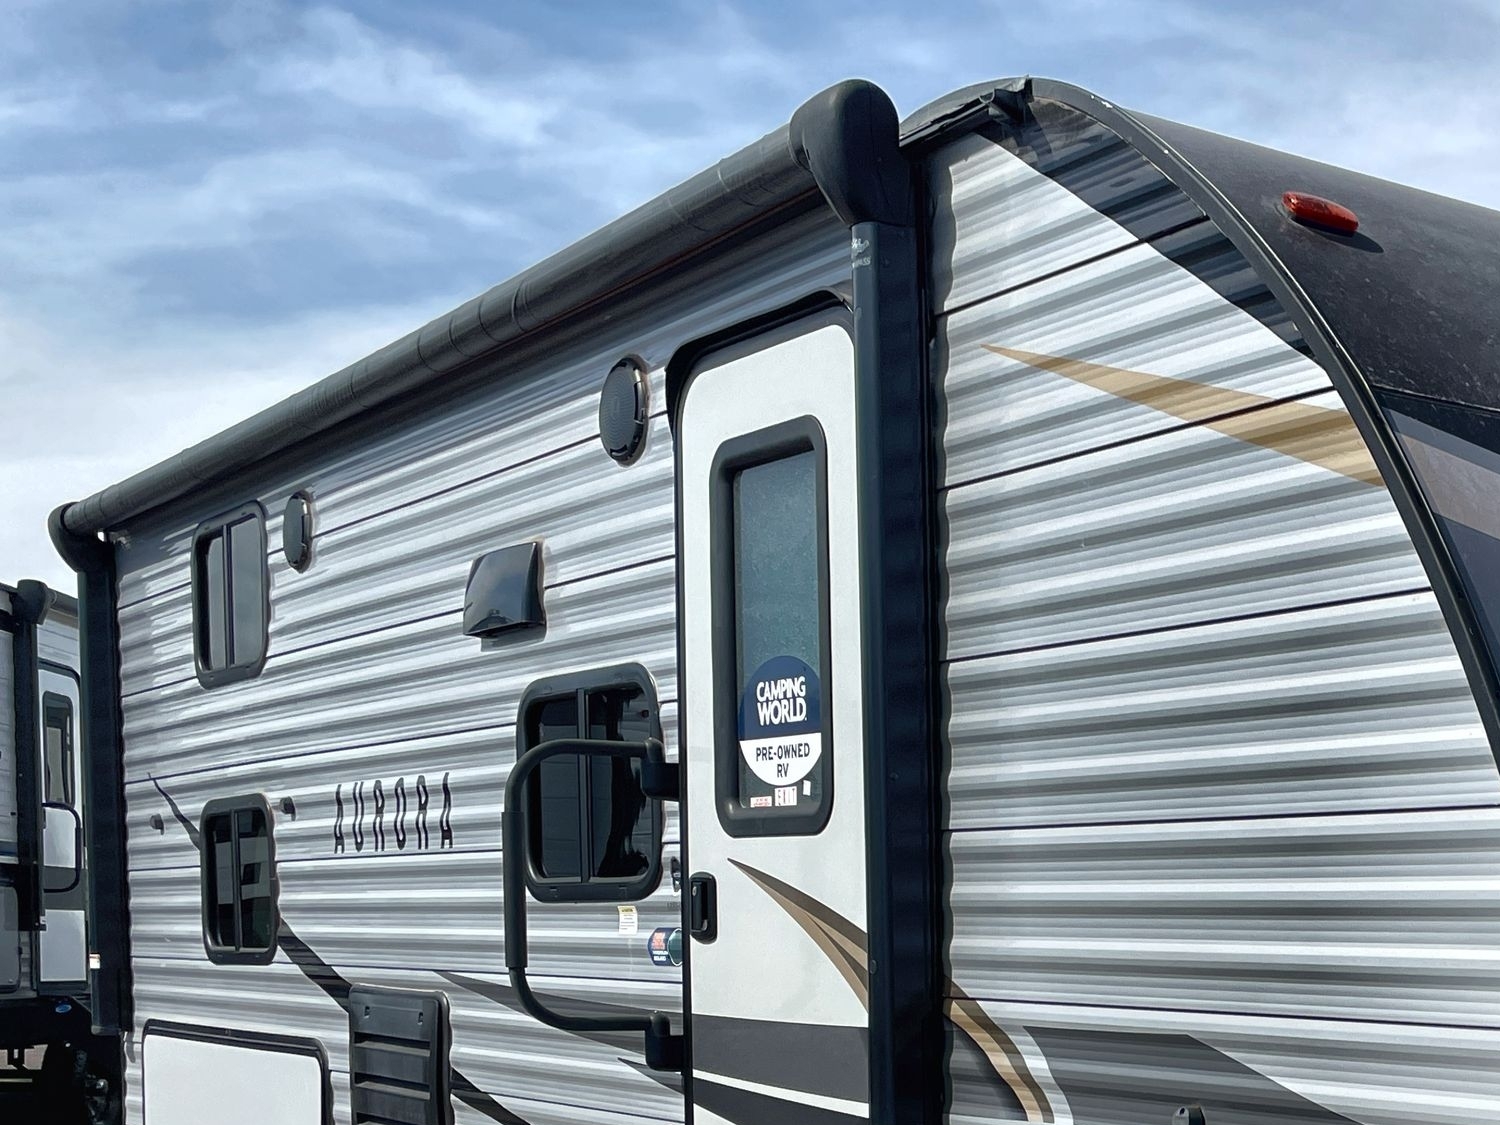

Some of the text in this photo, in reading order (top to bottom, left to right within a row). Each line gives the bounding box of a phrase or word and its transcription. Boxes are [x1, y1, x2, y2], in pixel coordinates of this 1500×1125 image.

[756, 675, 806, 702] CAMPING
[755, 742, 811, 762] PRE-OWNED
[776, 762, 790, 778] RV
[334, 771, 453, 855] AURORA
